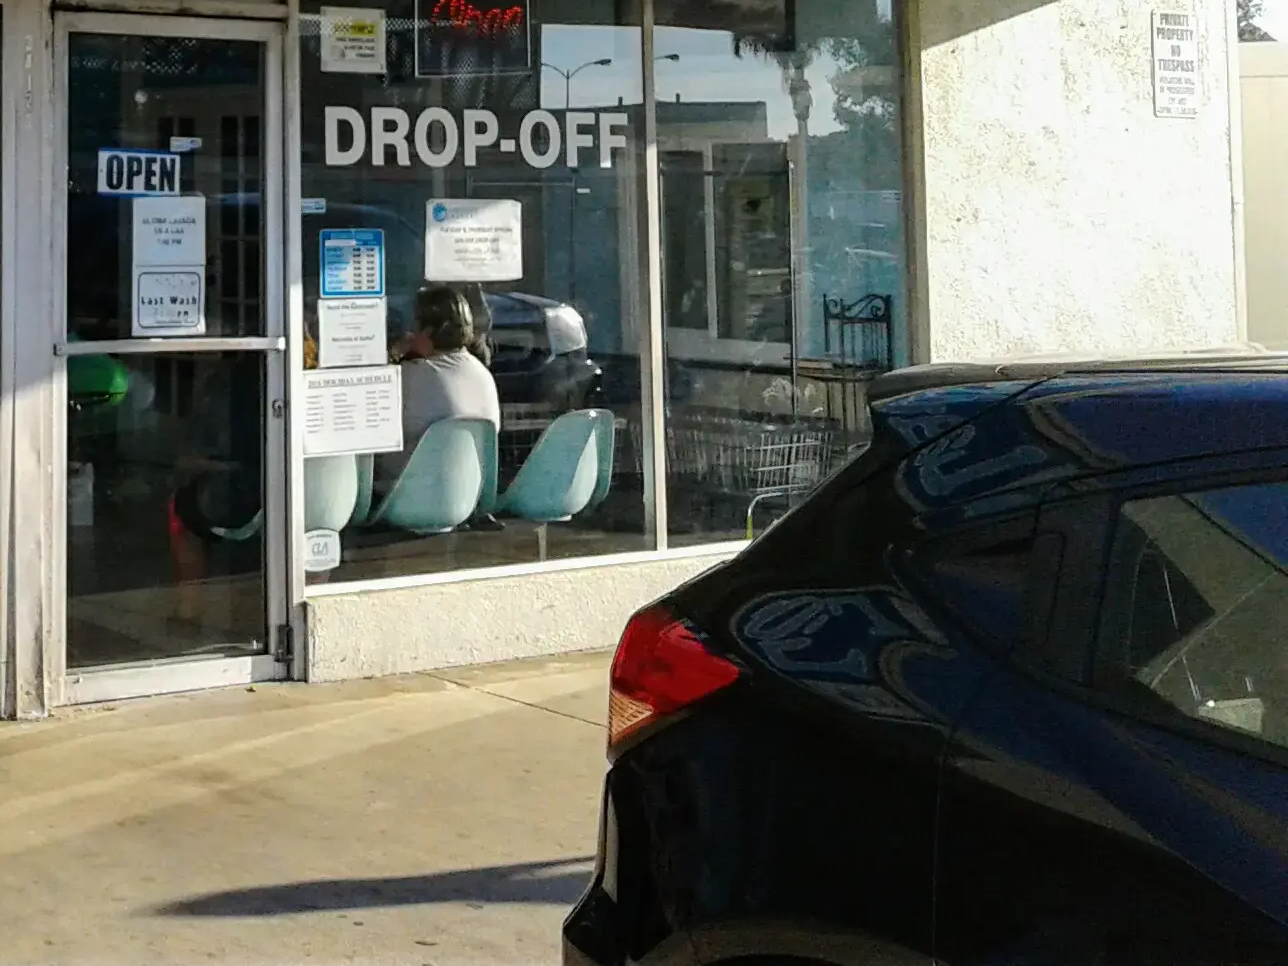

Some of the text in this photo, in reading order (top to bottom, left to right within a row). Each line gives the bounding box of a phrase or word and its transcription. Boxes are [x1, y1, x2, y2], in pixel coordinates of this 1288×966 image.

[1156, 27, 1194, 41] PROPERTY
[324, 106, 629, 169] DROP-OFF
[105, 154, 177, 193] OPEN
